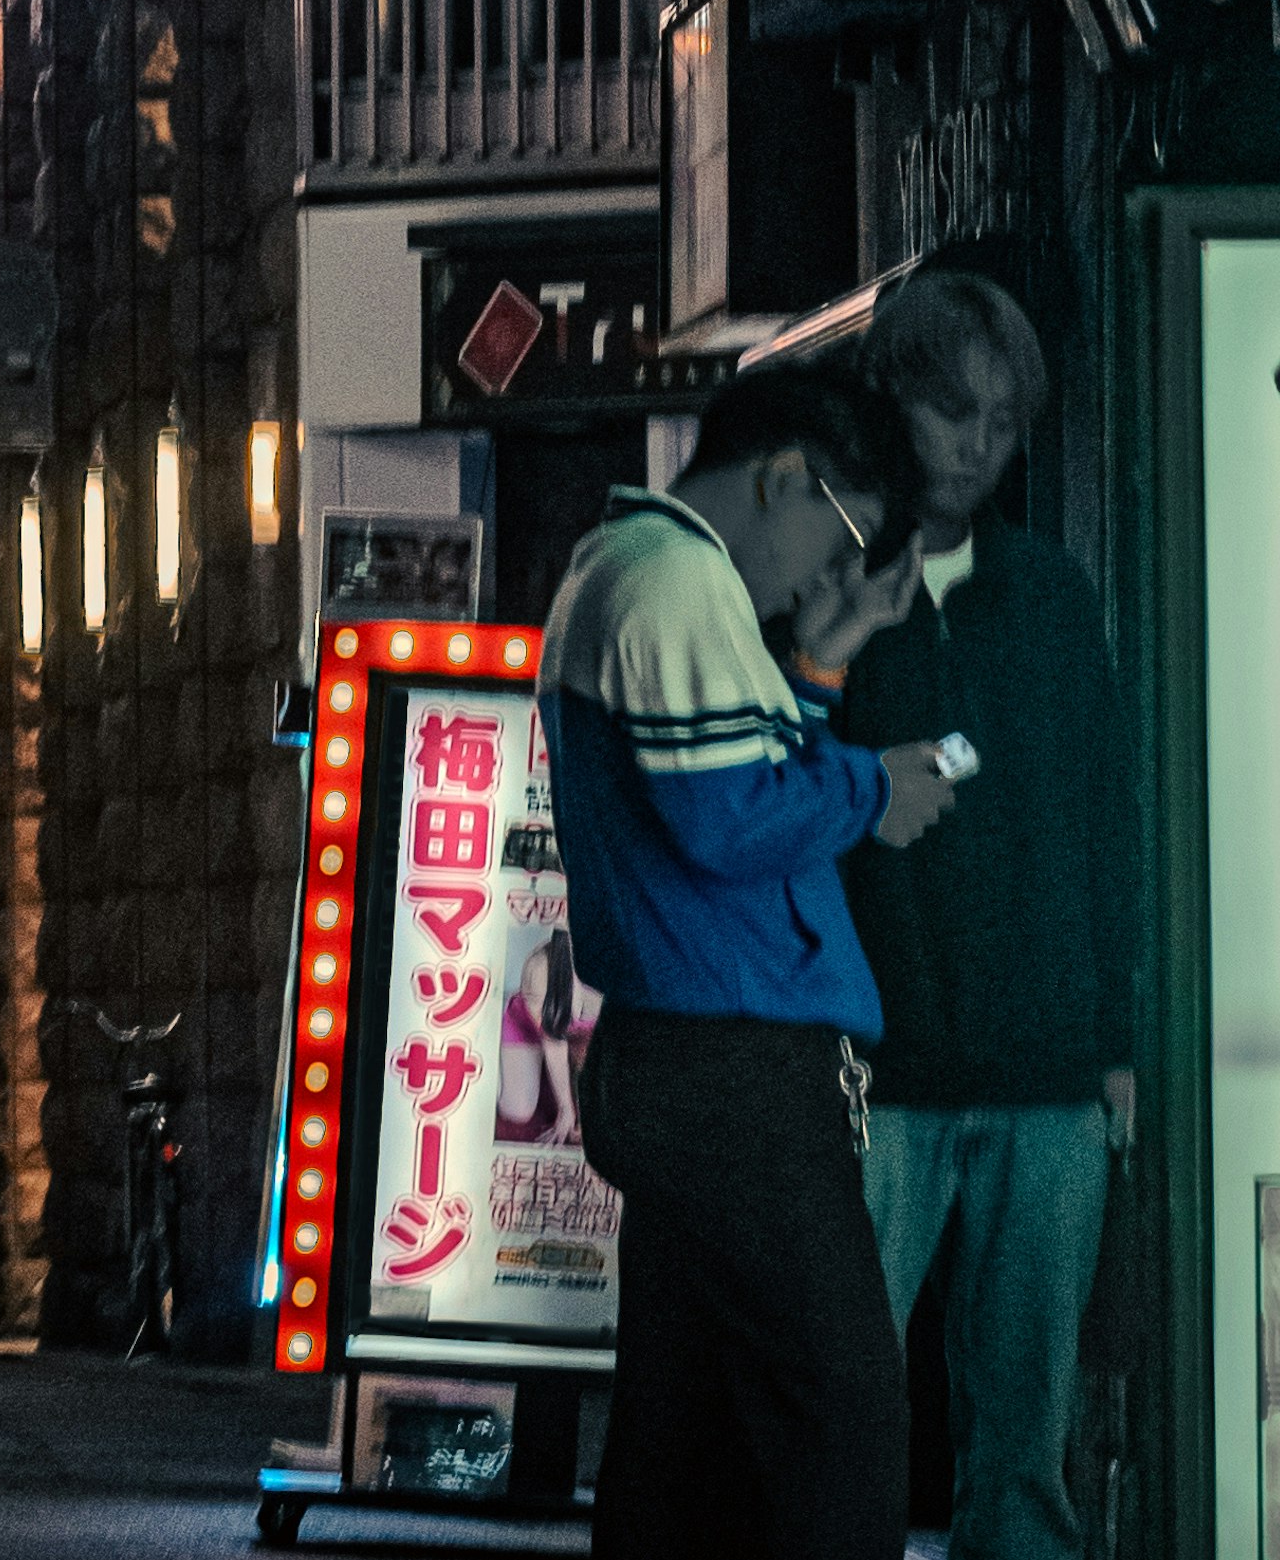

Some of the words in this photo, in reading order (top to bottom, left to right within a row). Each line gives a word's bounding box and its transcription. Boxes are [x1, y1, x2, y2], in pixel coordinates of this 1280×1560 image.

[383, 708, 501, 1280] 梅田マッサージ
